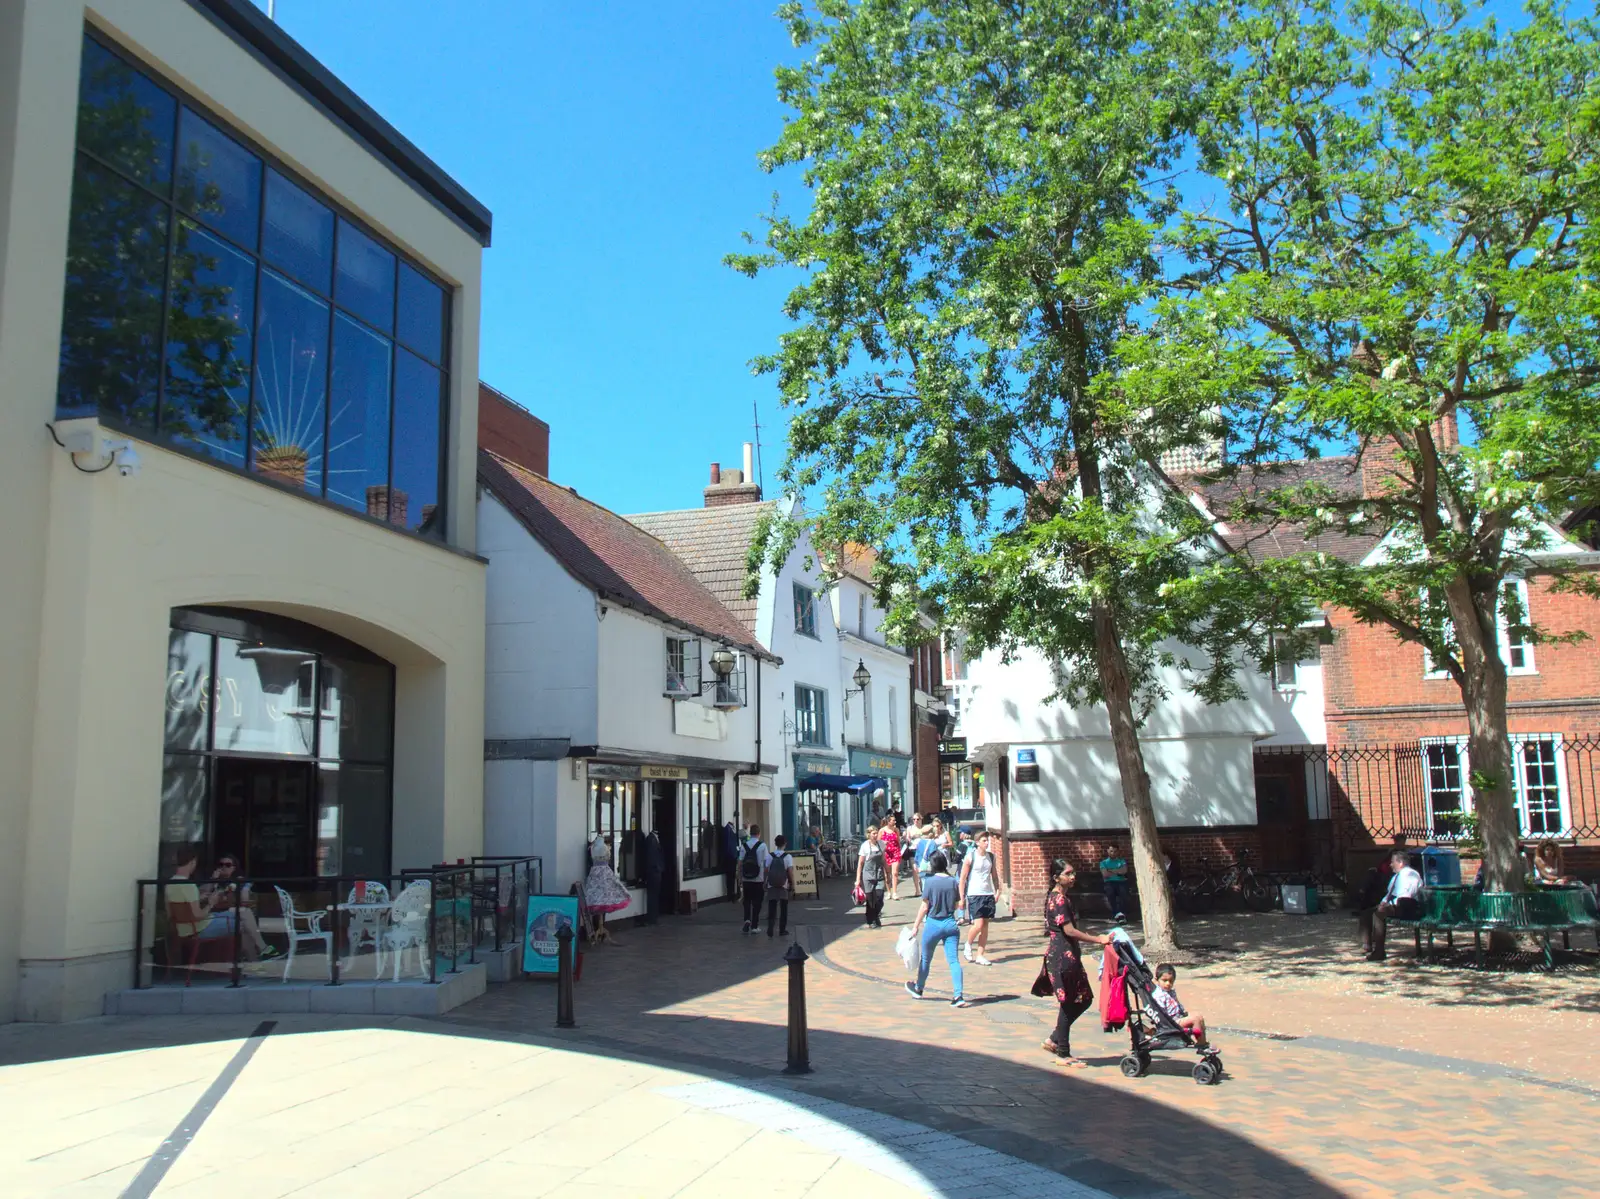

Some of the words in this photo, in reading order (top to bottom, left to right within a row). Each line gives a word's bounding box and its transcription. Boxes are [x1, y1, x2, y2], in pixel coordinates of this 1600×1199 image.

[649, 767, 661, 776] twist
[668, 767, 681, 777] shout
[1143, 1003, 1161, 1024] Joie
